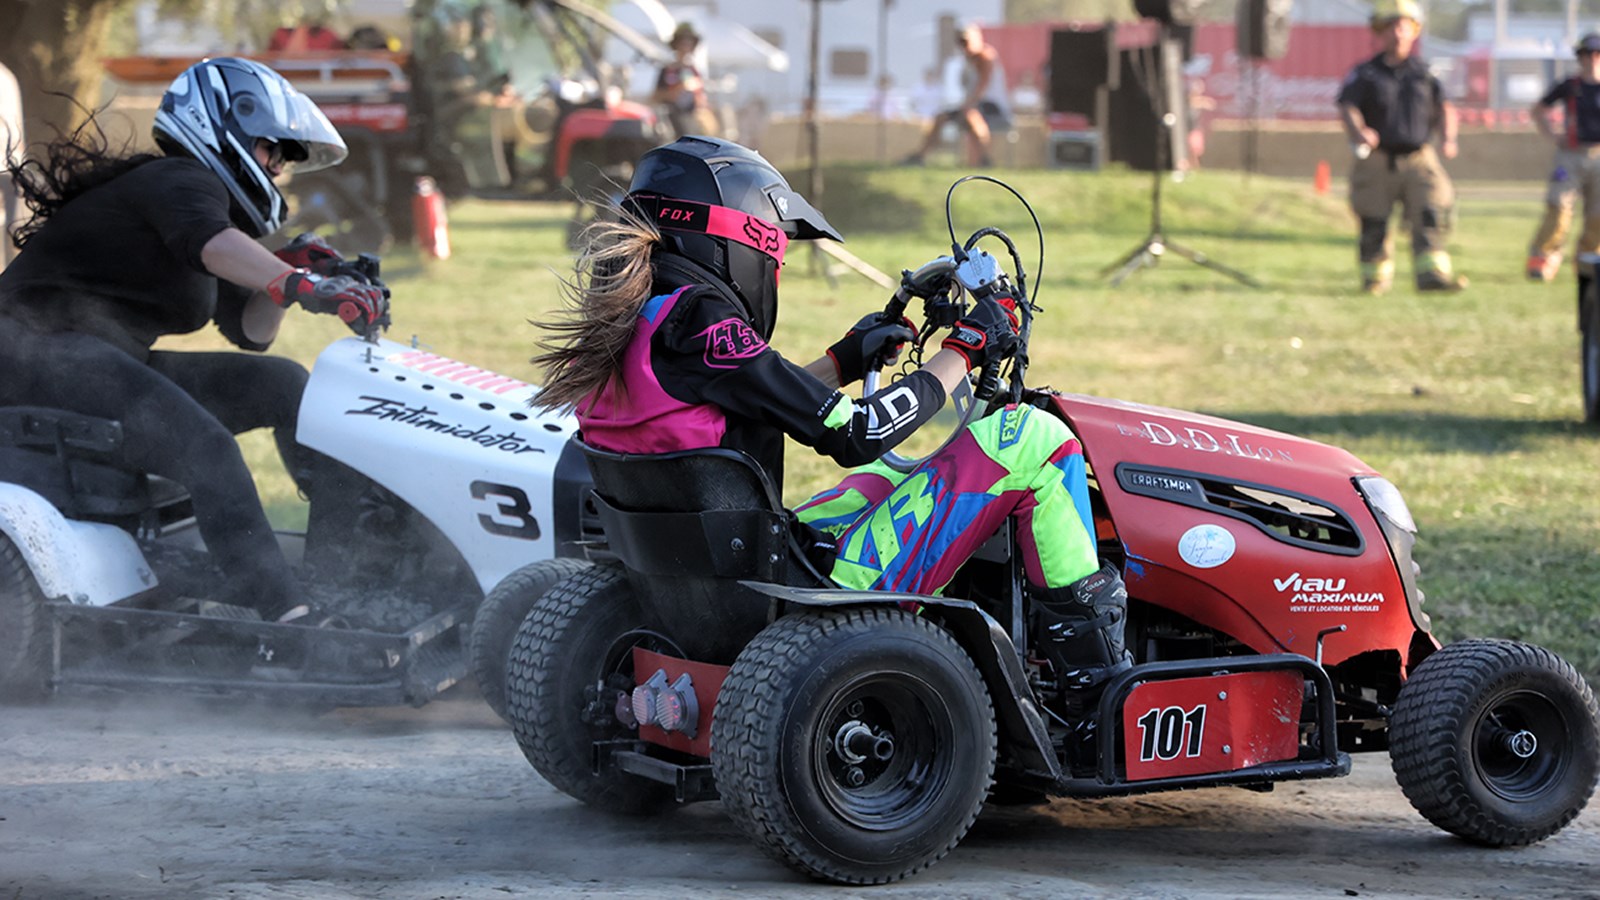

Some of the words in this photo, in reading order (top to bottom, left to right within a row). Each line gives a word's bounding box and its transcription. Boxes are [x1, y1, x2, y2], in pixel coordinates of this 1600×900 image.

[659, 207, 695, 222] FOX
[344, 395, 546, 454] Intimidator
[1131, 473, 1193, 492] CRAFTSMAN
[469, 480, 541, 541] 3
[1352, 604, 1380, 612] VÉHICULES
[1137, 704, 1206, 762] 101
